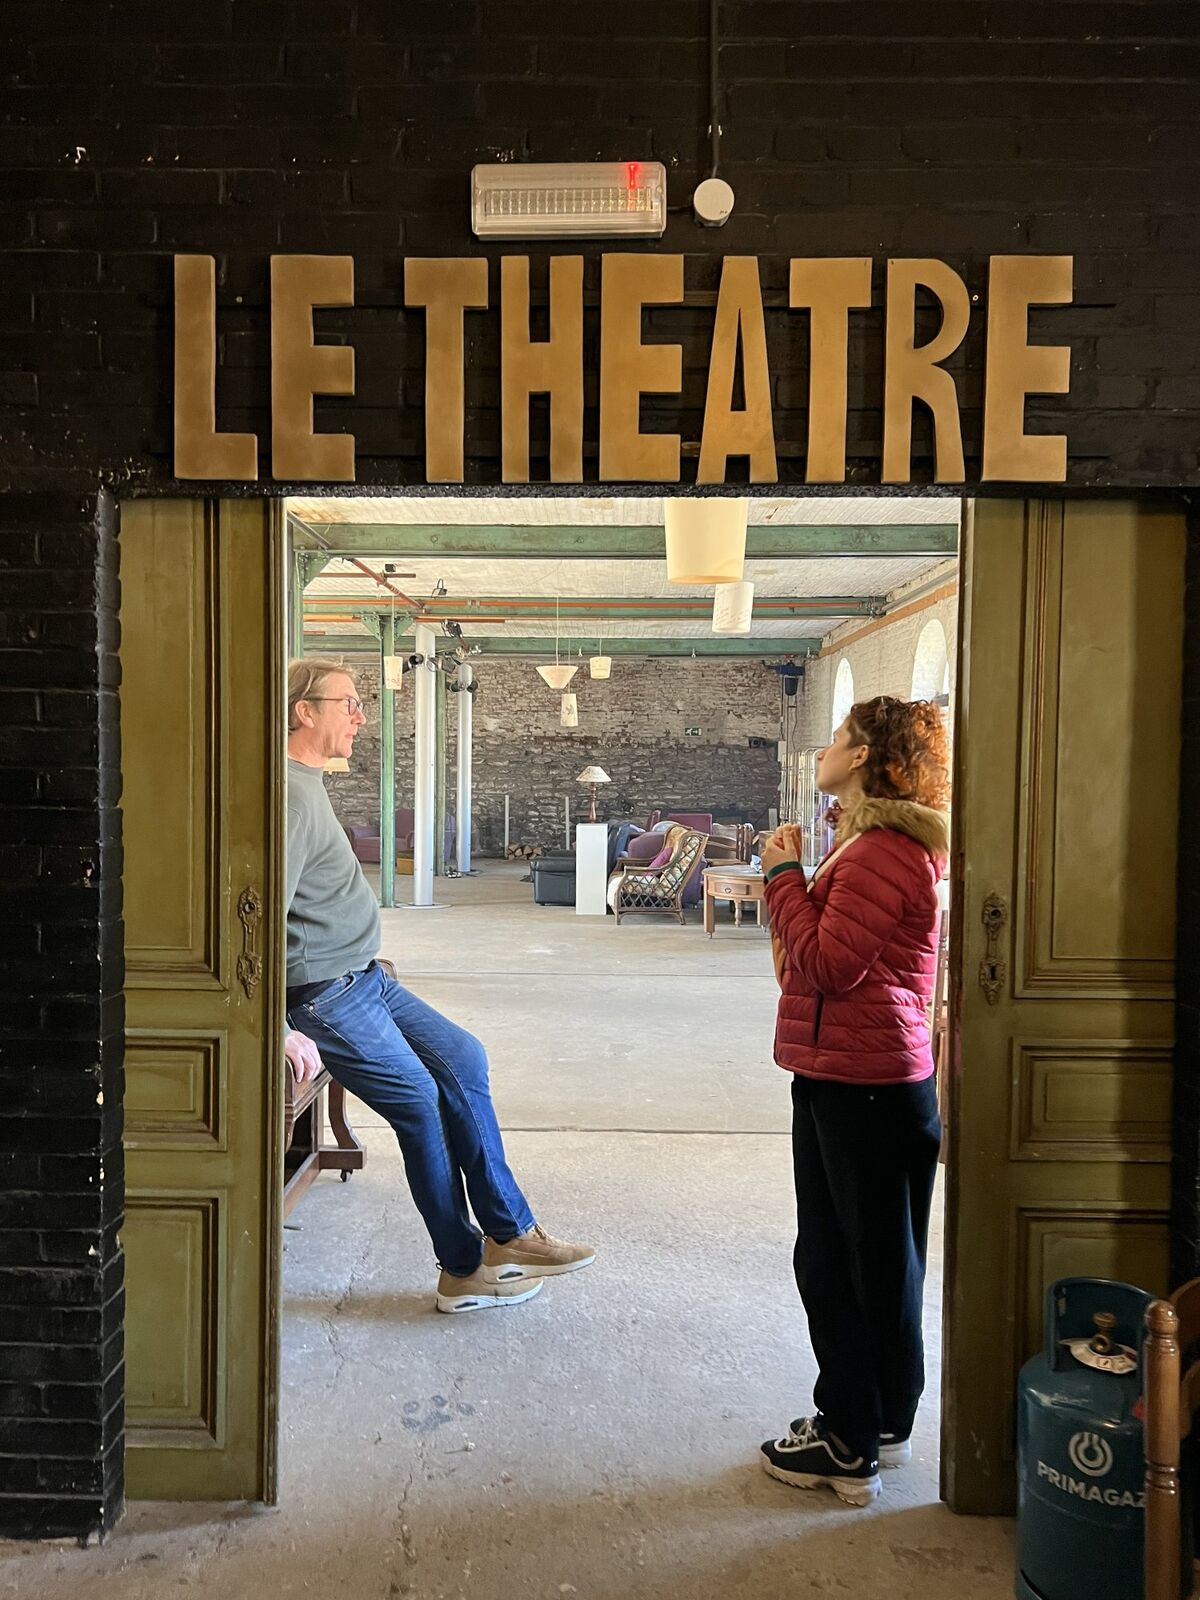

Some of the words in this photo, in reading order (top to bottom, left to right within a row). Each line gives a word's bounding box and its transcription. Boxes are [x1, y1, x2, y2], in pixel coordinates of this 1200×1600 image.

[174, 254, 355, 481] LE
[404, 252, 1074, 483] THEATRE
[1037, 1460, 1146, 1508] PRIMAGAZ
